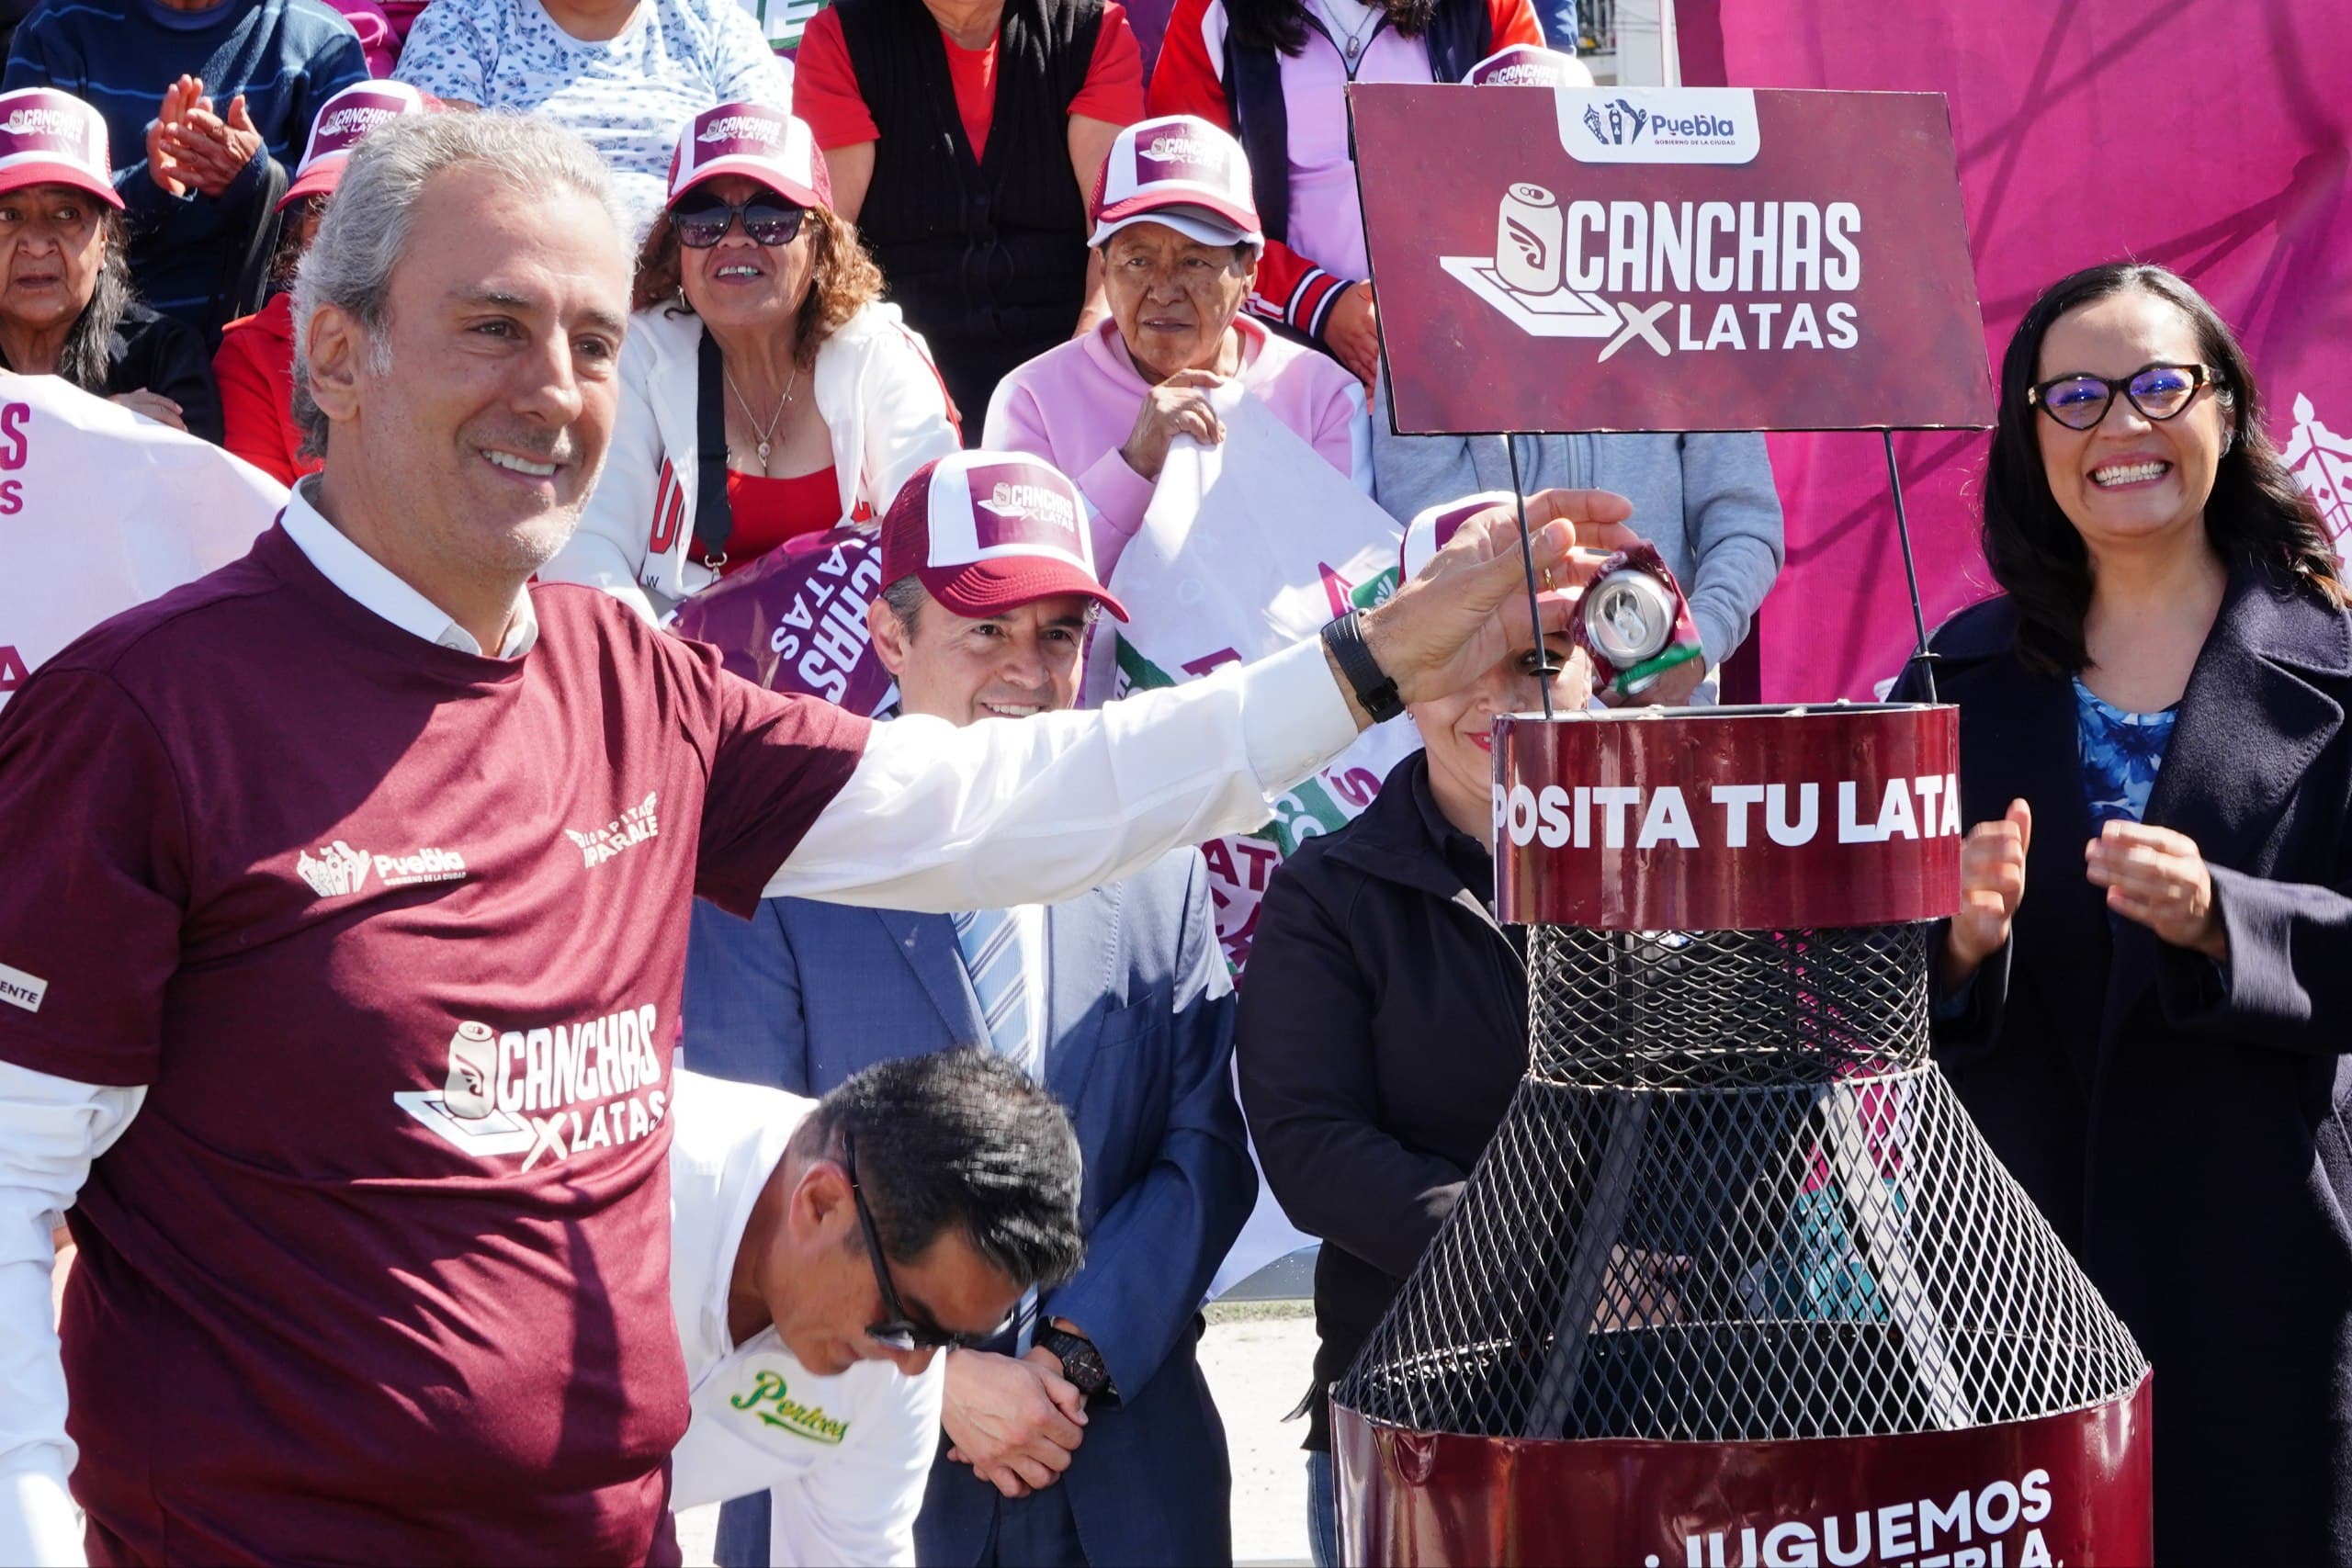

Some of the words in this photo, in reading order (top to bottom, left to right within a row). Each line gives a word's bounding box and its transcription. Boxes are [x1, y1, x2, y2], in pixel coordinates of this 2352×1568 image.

[718, 116, 783, 138] CANCHAS
[1651, 115, 1734, 136] Puebla
[1566, 200, 1861, 292] CANCHAS
[1598, 300, 1674, 364] X
[1679, 302, 1859, 351] LATAS
[798, 547, 882, 705] CHAS
[1712, 783, 1819, 847] TU
[1838, 773, 1960, 843] LATA
[372, 847, 466, 879] Puebla
[497, 1003, 662, 1114] CANCHAS
[521, 1111, 568, 1174] X
[570, 1090, 666, 1154] LATAS
